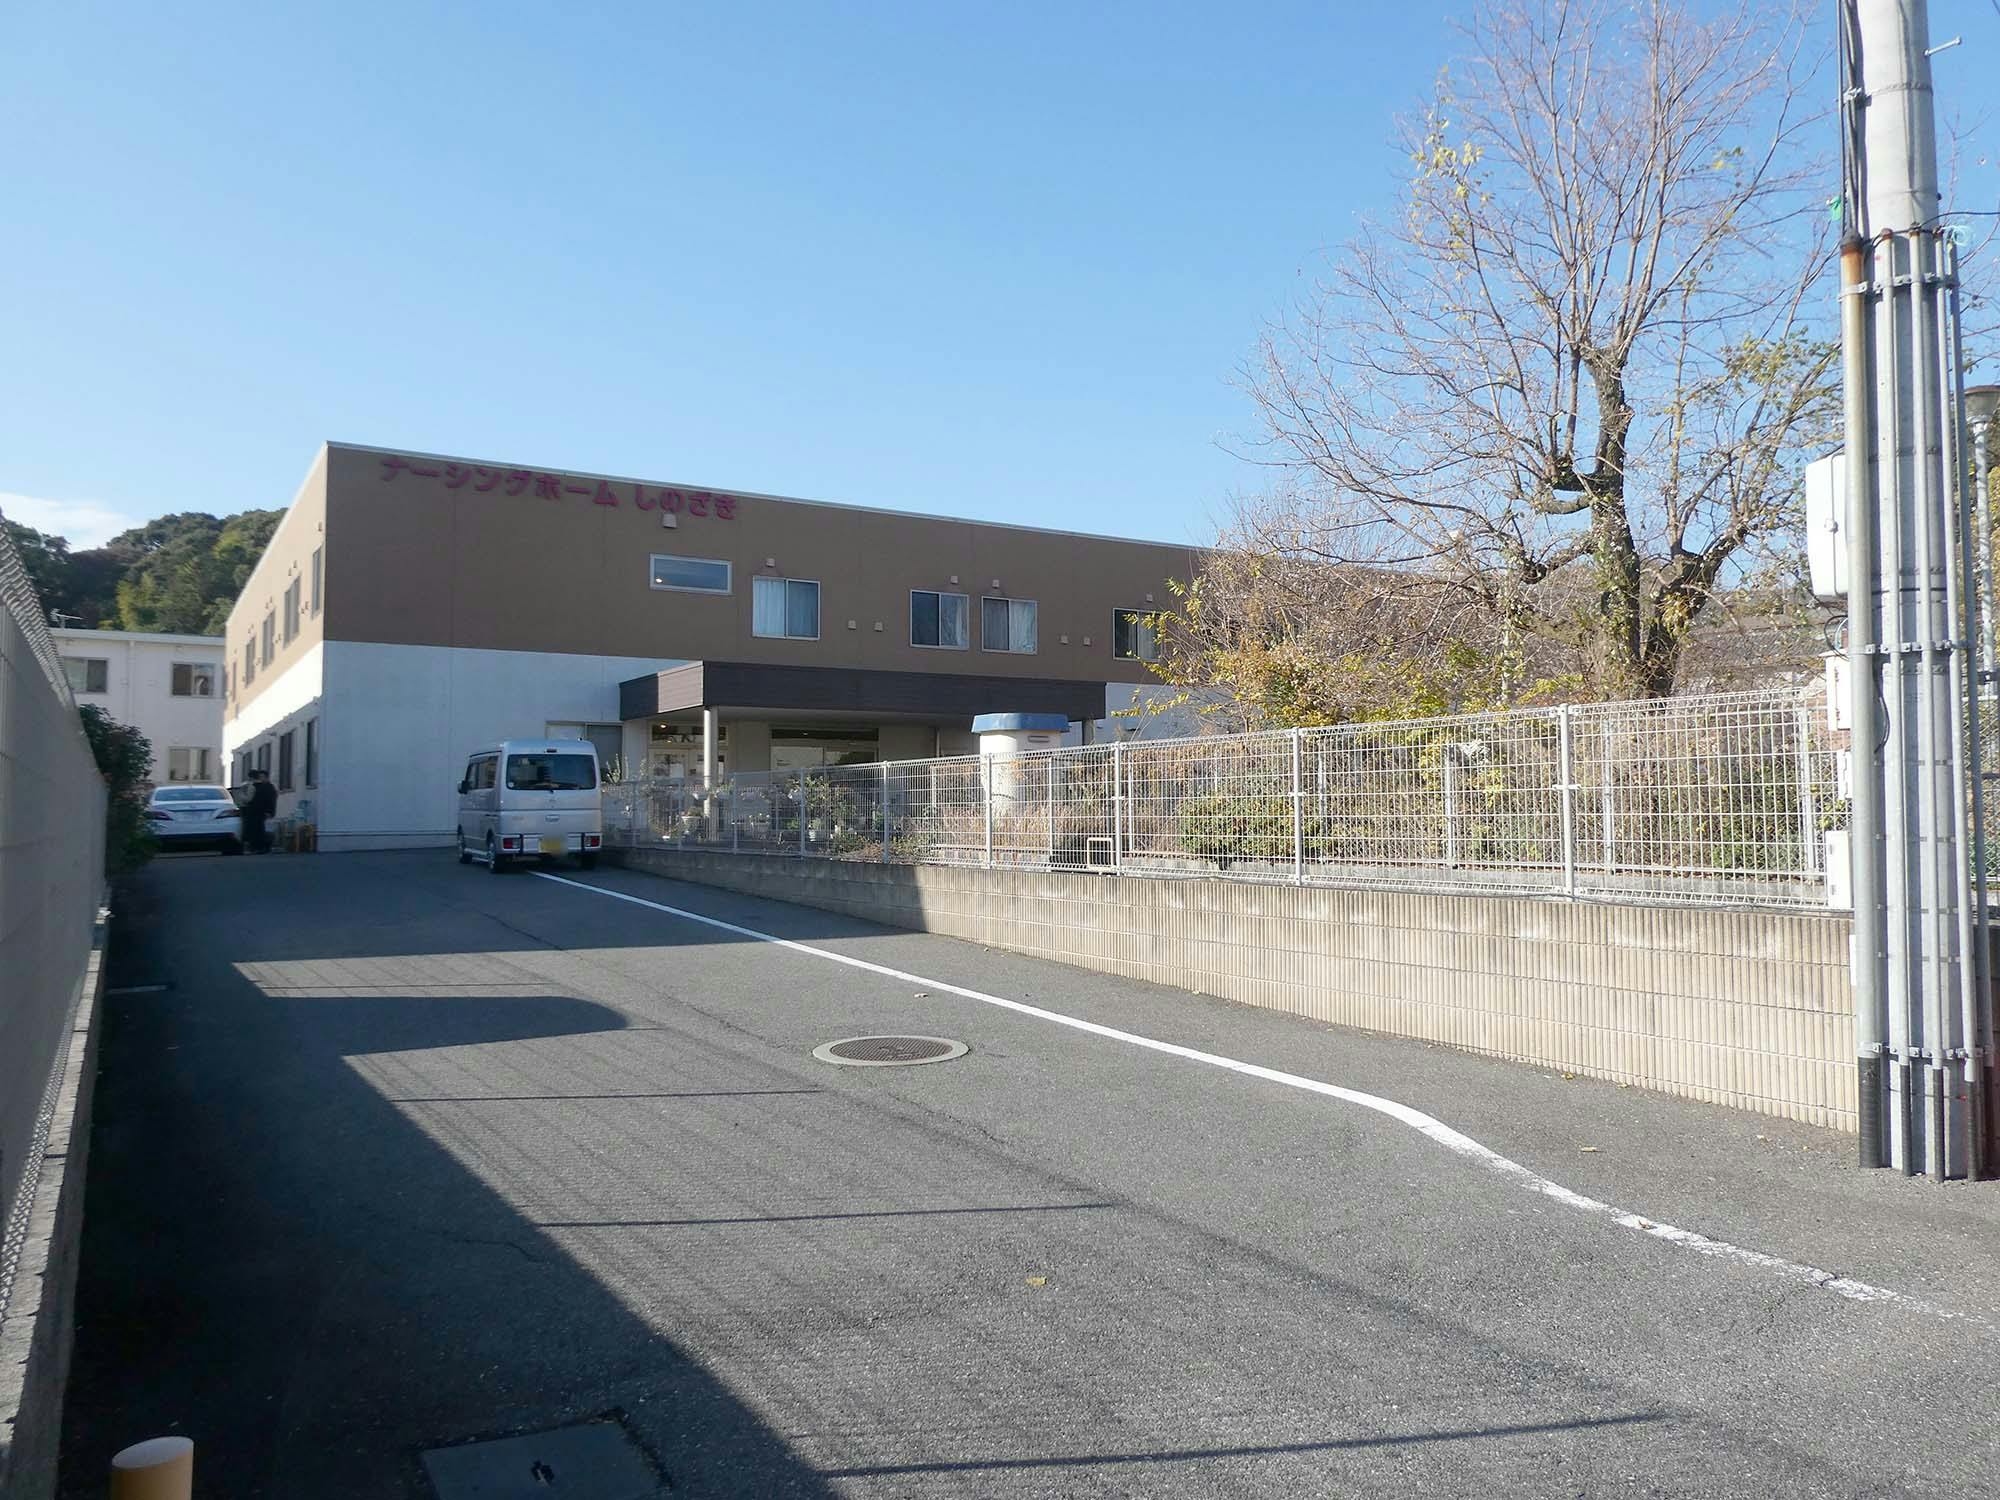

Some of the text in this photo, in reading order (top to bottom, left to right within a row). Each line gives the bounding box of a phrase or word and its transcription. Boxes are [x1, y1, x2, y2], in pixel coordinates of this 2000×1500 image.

[380, 456, 620, 507] ナーシングホーム
